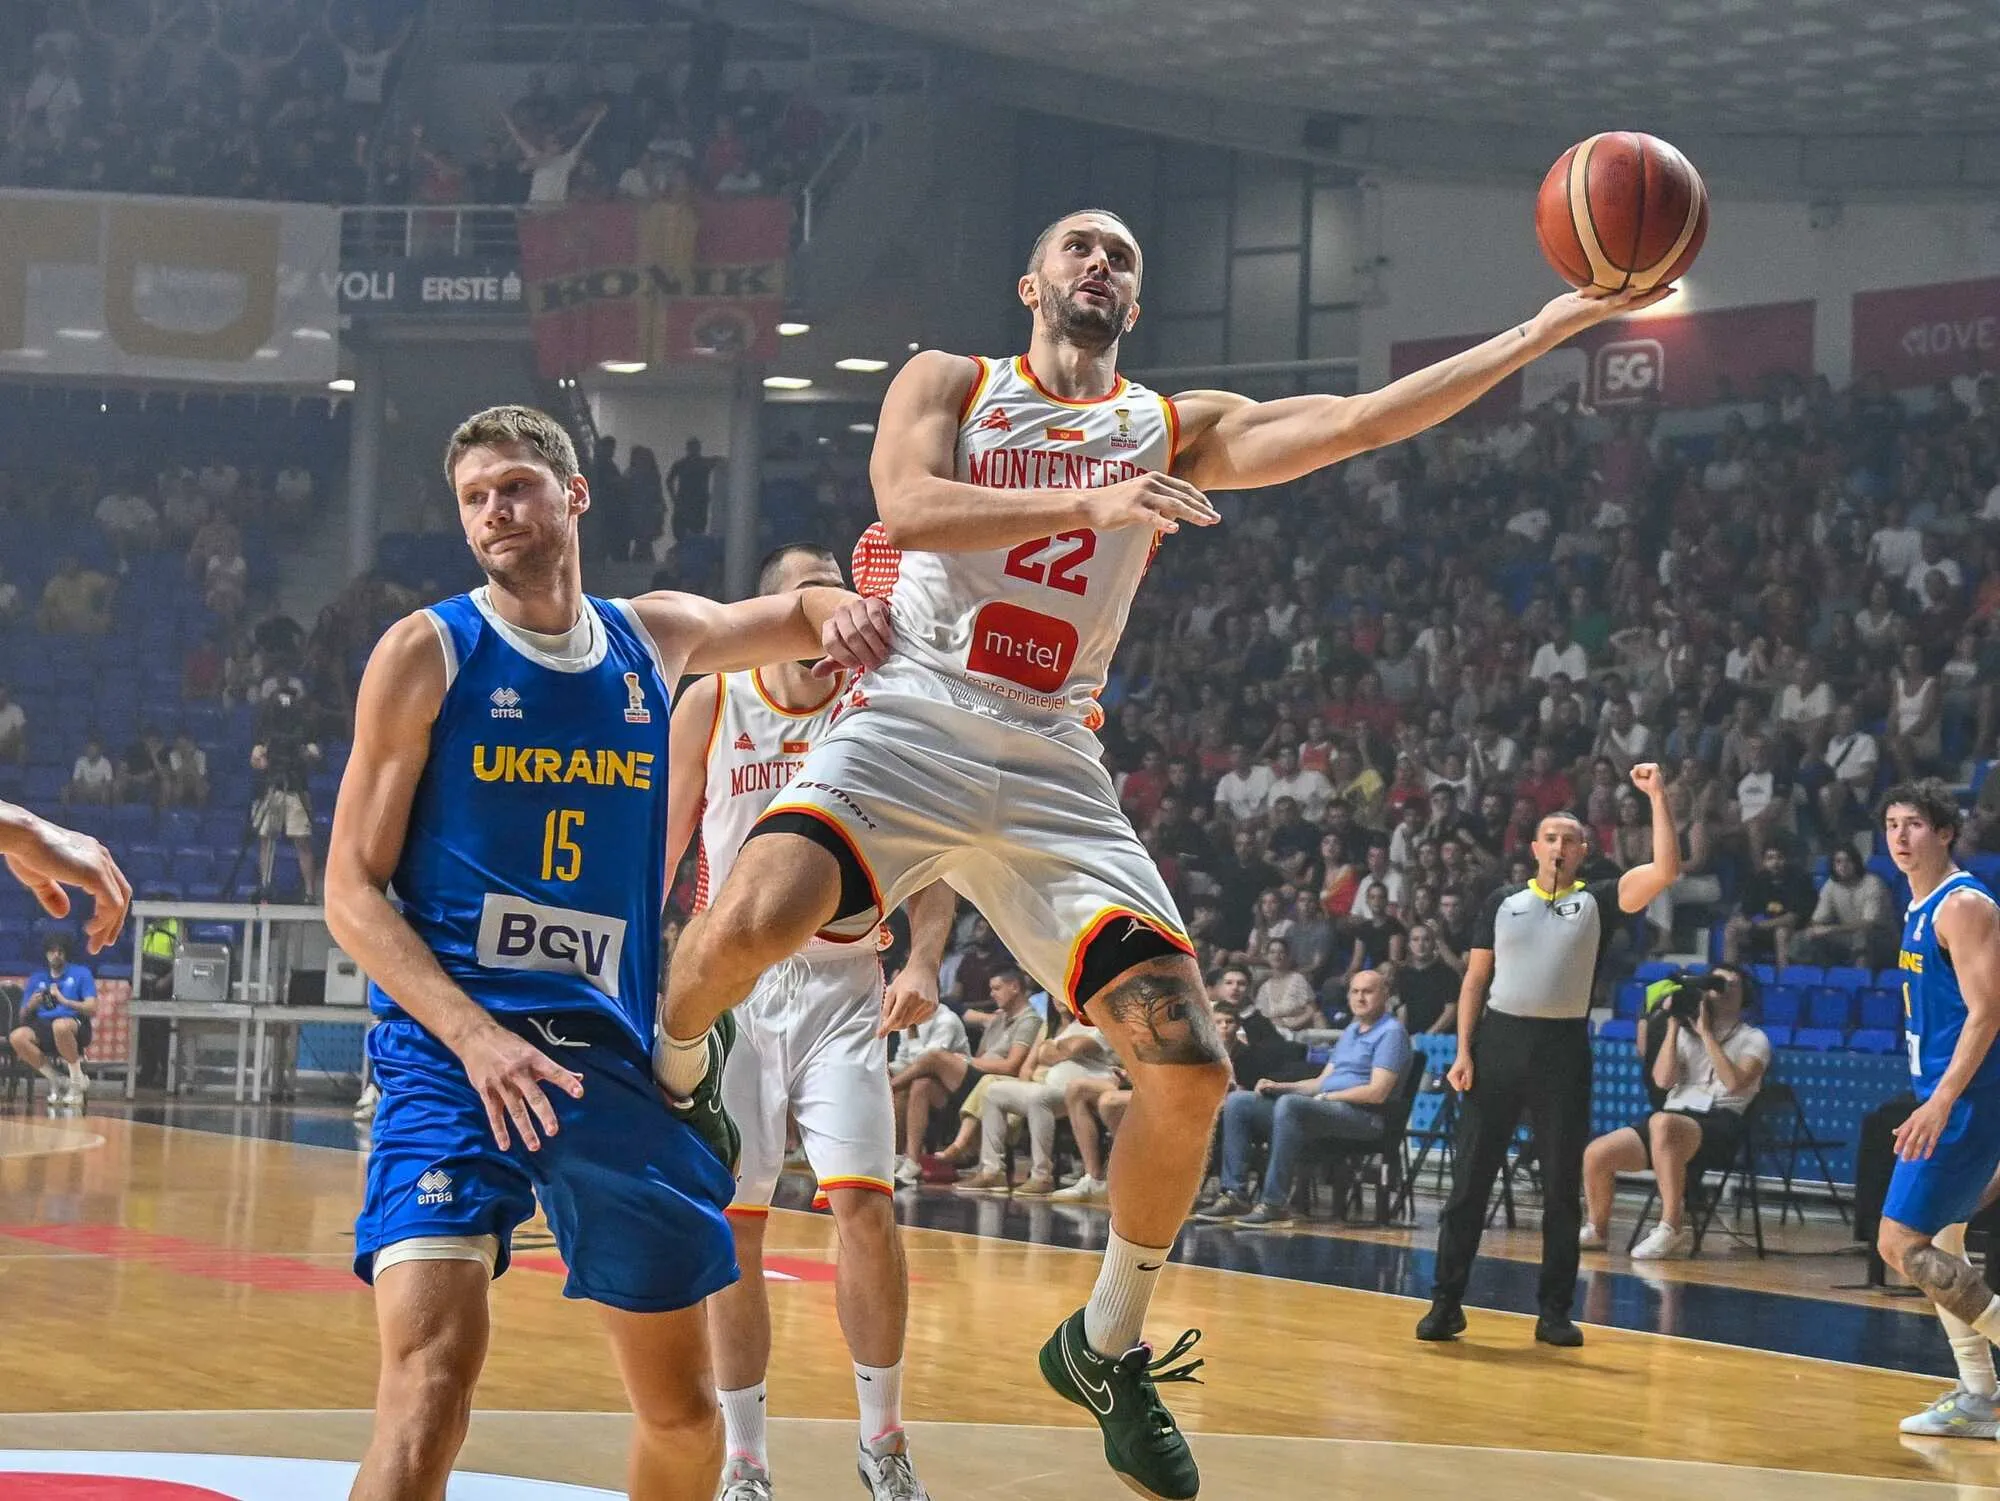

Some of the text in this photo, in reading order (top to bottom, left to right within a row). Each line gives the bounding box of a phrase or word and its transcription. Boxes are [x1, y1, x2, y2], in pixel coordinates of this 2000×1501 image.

[421, 276, 498, 301] ERSTE
[1606, 353, 1652, 390] 5G
[969, 449, 1151, 489] MONTENEGR
[1004, 528, 1096, 596] 22
[985, 630, 1062, 672] m:tel
[473, 745, 655, 790] UKRAINE
[541, 809, 585, 881] 15
[496, 912, 610, 977] BGV
